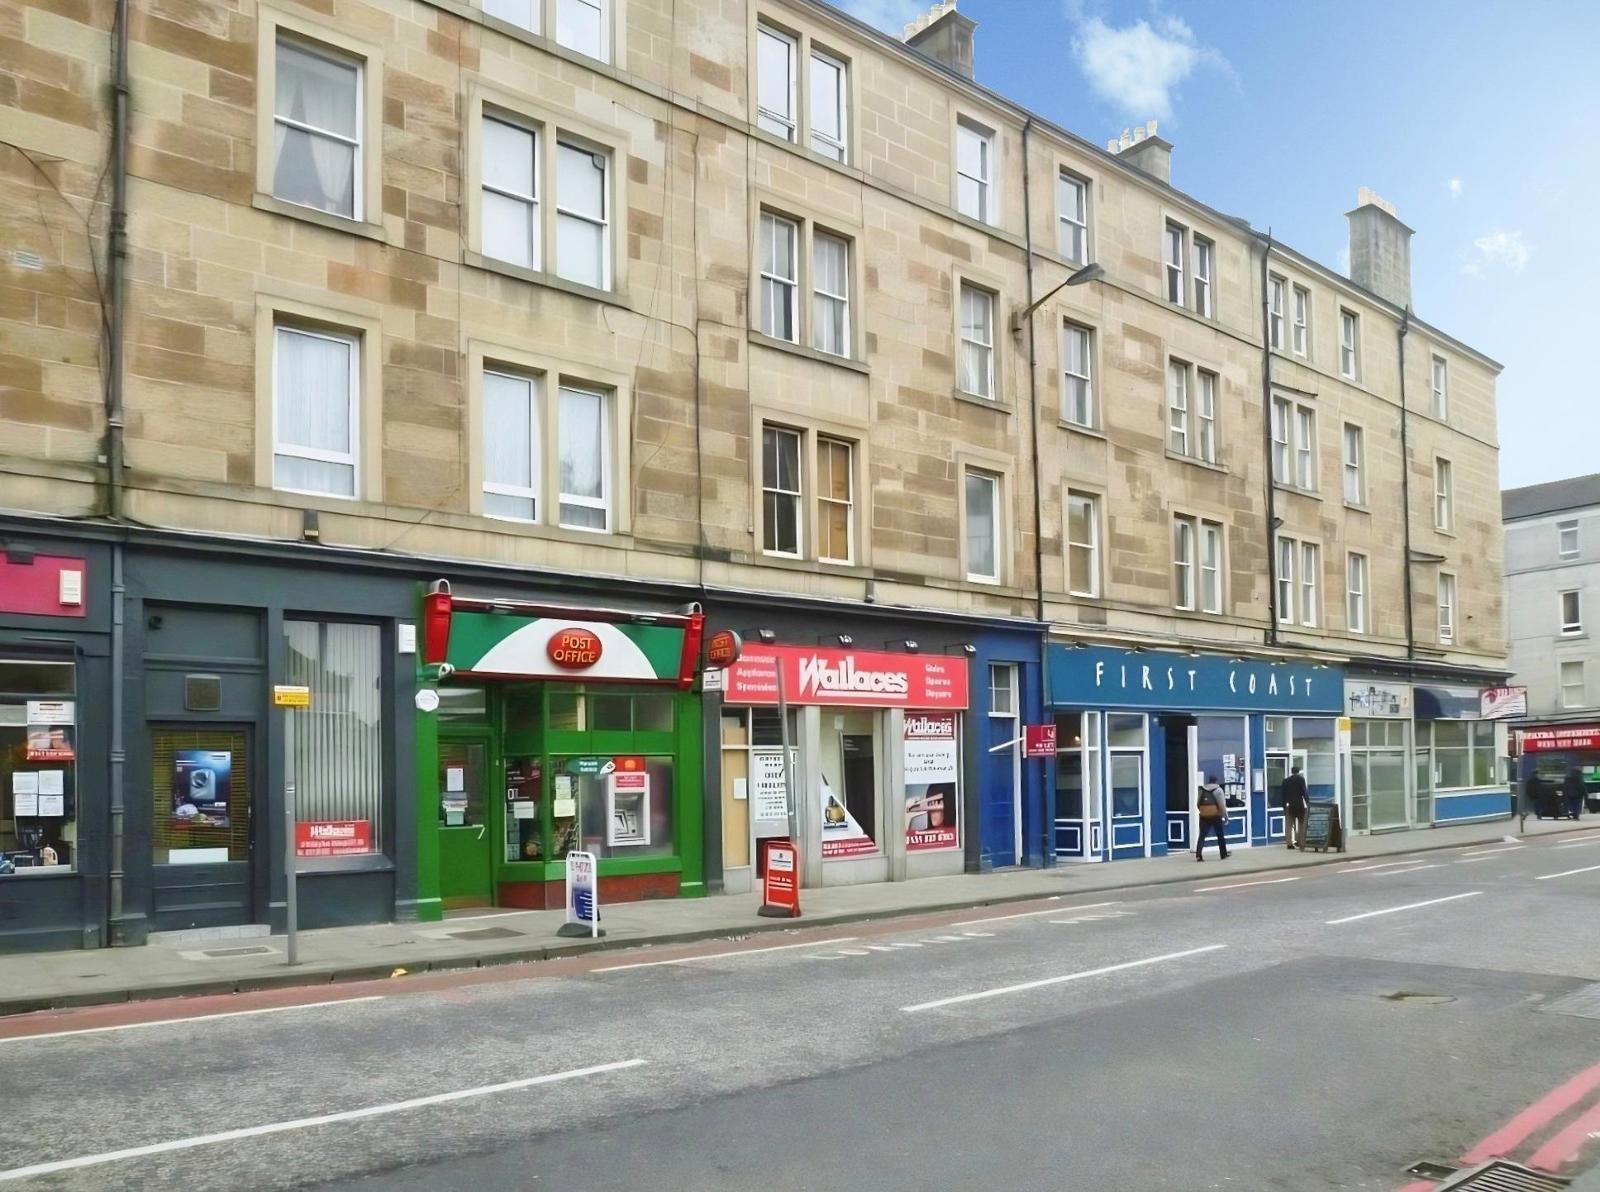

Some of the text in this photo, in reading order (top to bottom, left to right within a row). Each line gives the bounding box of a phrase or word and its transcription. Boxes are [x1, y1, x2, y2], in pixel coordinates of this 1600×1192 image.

[562, 635, 594, 649] POST
[553, 648, 596, 662] OFFICE
[799, 654, 908, 698] Wallaces
[1096, 661, 1312, 697] FIRST COAST
